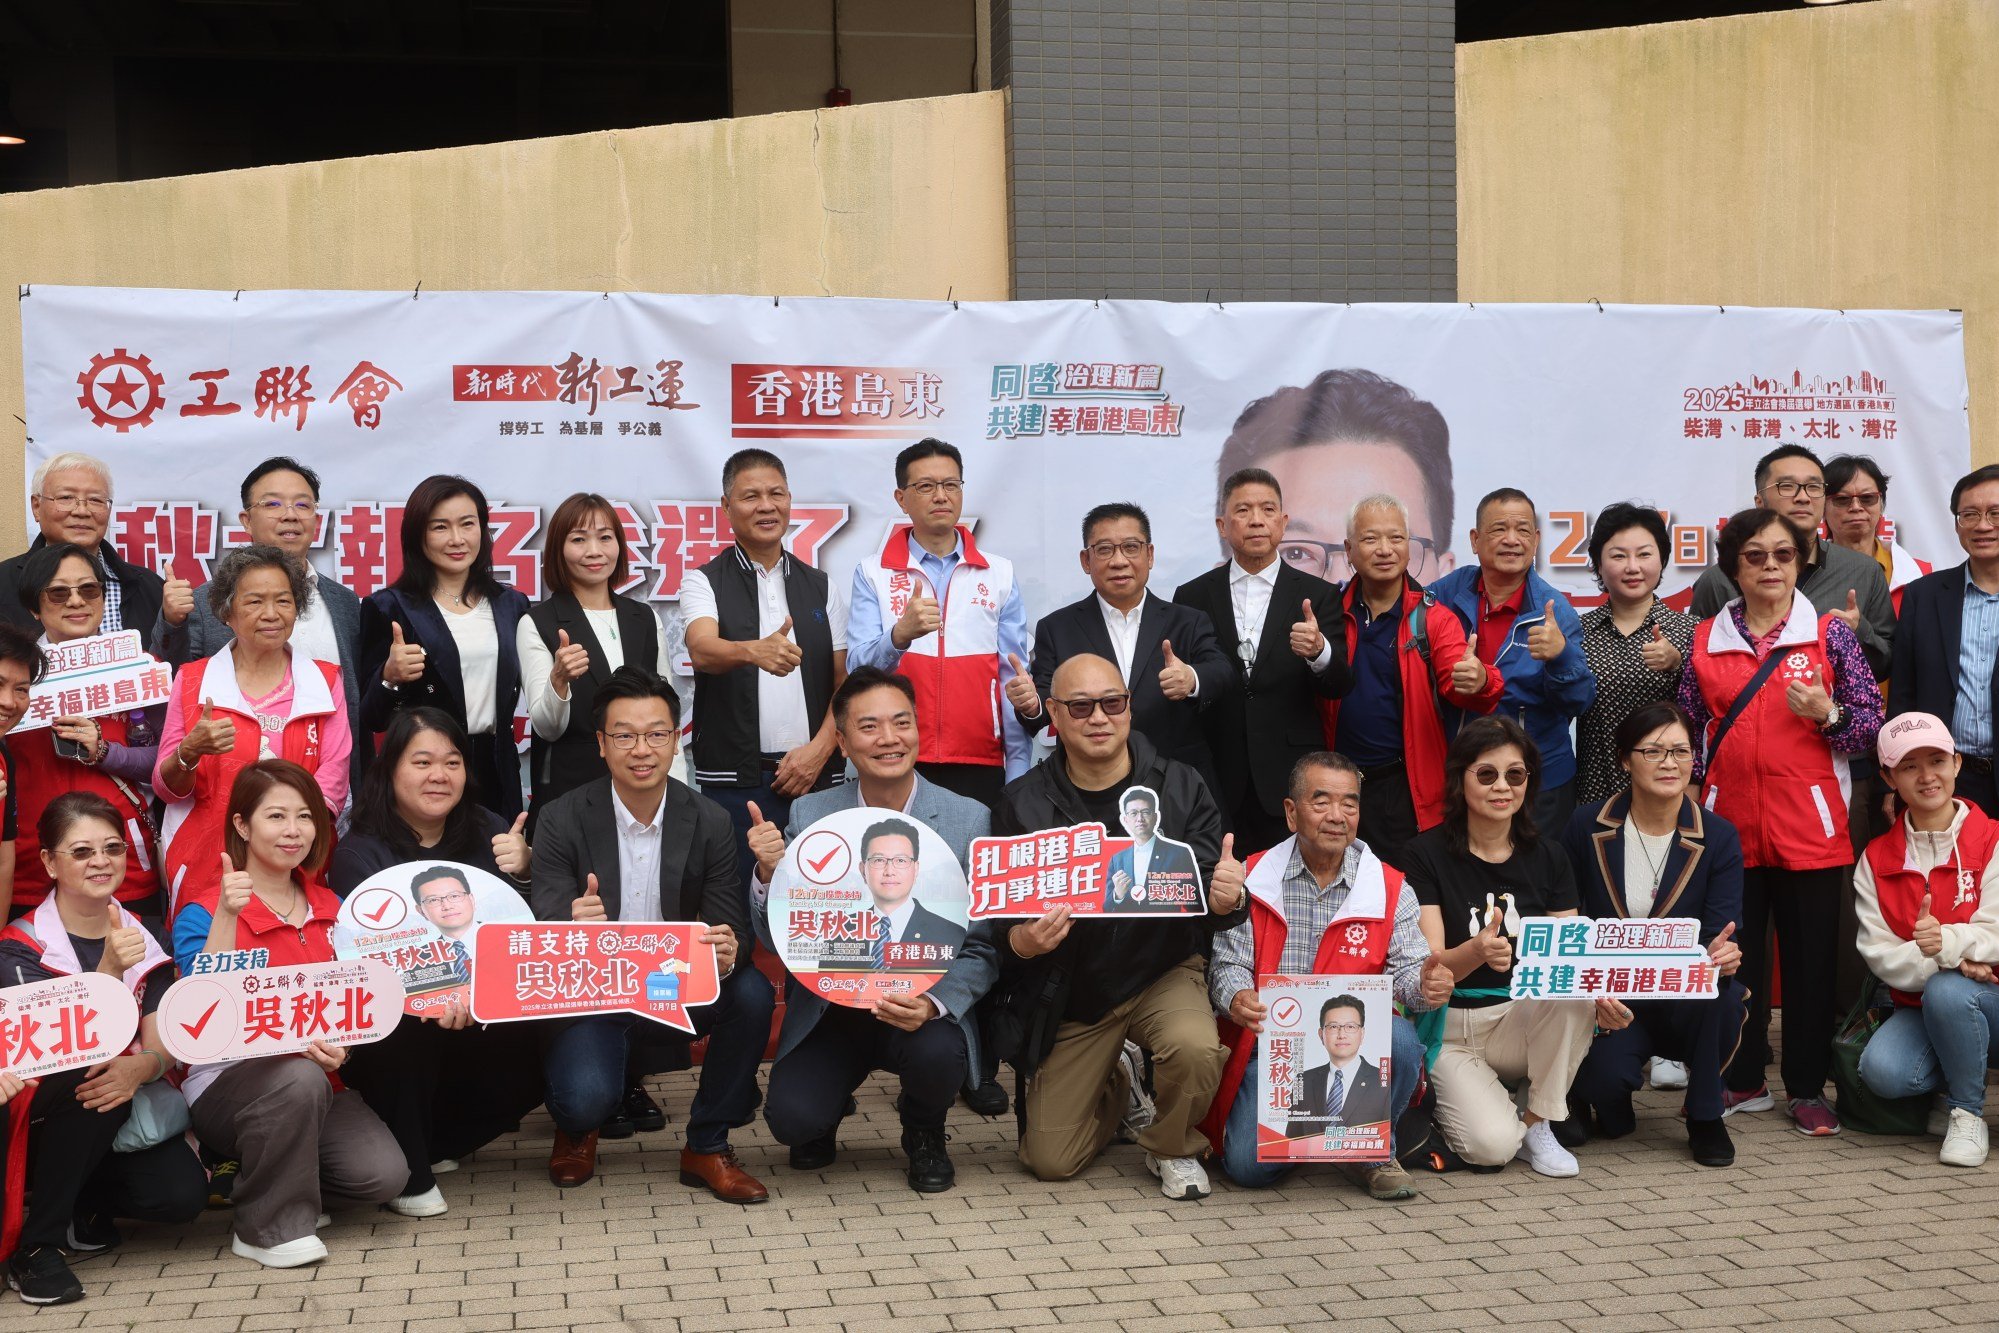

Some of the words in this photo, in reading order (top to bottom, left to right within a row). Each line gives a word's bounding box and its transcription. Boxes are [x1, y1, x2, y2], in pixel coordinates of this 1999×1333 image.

[179, 360, 403, 431] 工聯會
[747, 370, 945, 419] 香港島東
[500, 421, 544, 436] 撐勞工
[559, 421, 603, 436] 為基層
[1890, 719, 1931, 738] FILA
[976, 829, 1101, 878] 扎根港島
[975, 862, 1102, 913] 力爭連任
[1148, 883, 1197, 901] 吳秋北
[787, 909, 881, 941] 吳秋北
[507, 929, 590, 956] 請支持
[622, 932, 681, 954] 工聯會
[888, 944, 955, 961] 香港島東
[194, 949, 269, 974] 全力支持
[263, 972, 308, 991] 工聯會
[515, 957, 641, 1000] 吳秋北
[243, 986, 375, 1045] 吳秋北
[0, 1004, 101, 1070] 秋北
[1269, 1037, 1293, 1110] 吳秋北
